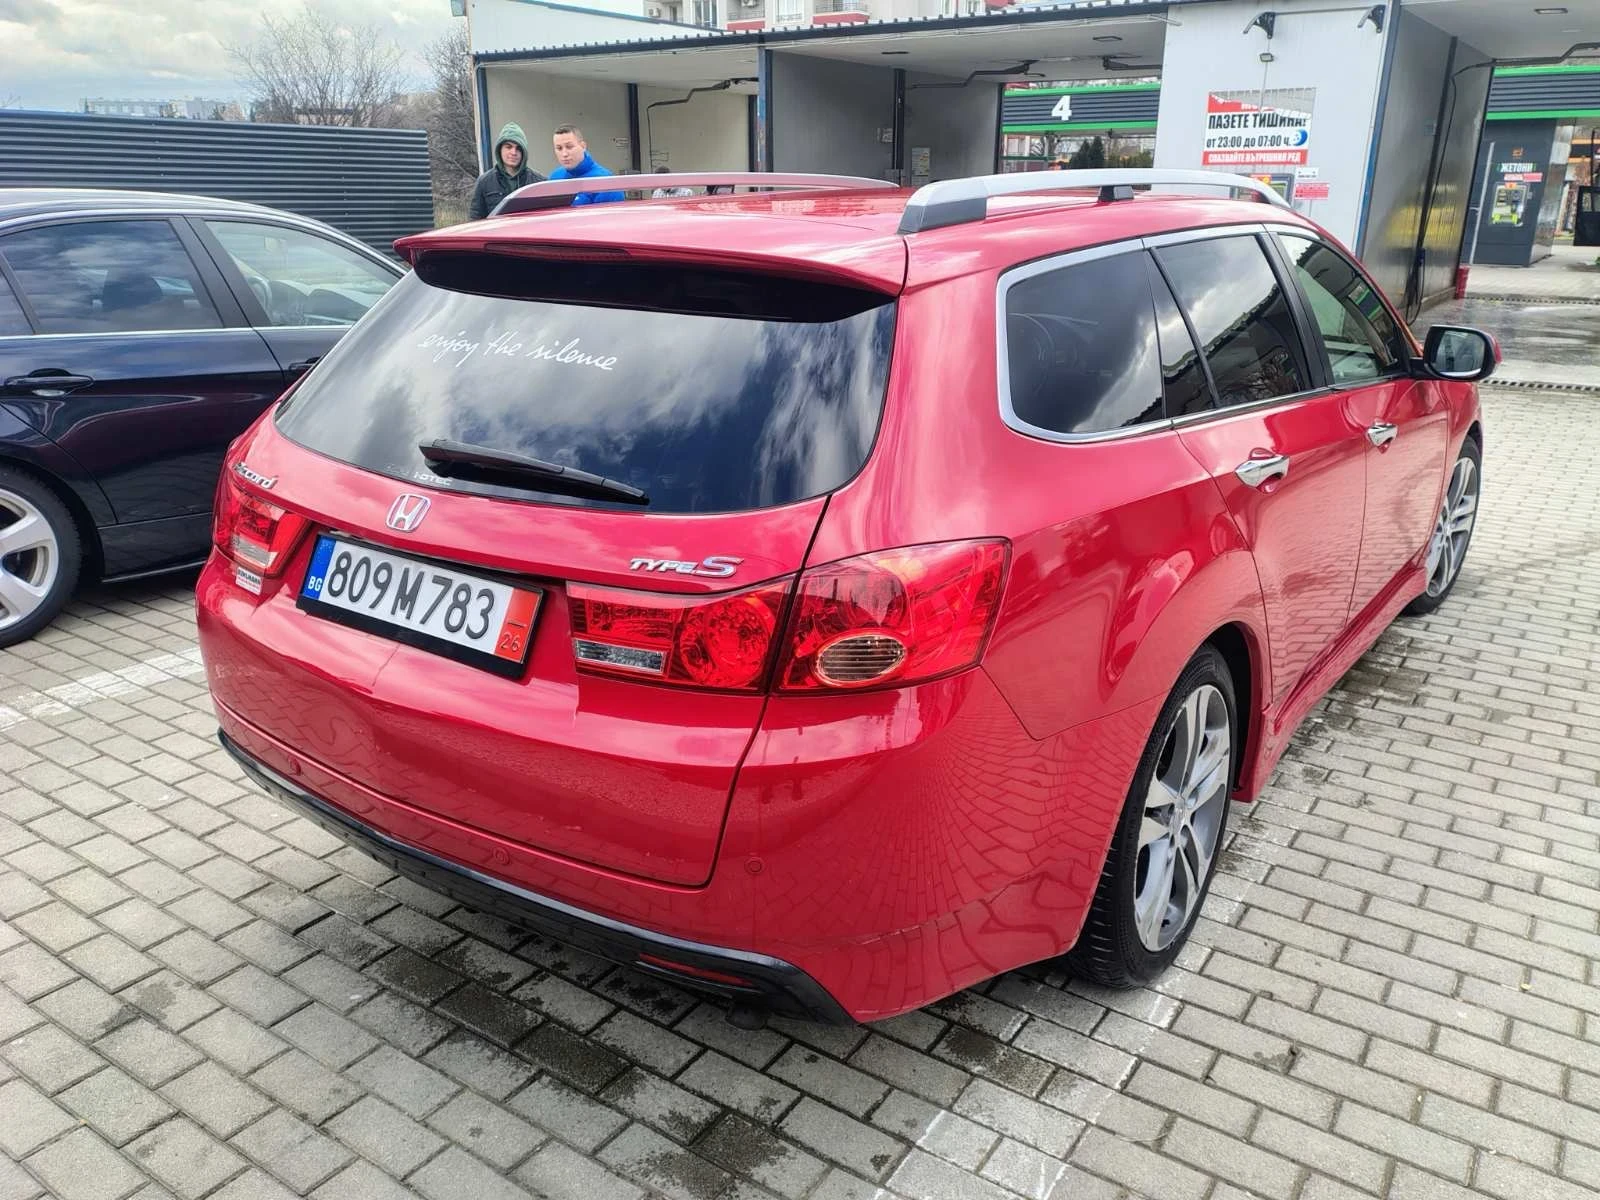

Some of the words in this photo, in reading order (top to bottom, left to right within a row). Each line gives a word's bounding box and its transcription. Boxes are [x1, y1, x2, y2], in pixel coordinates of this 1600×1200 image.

[1051, 95, 1072, 121] 4
[1208, 114, 1249, 130] ПАЗЕТЕ
[1206, 138, 1216, 148] от
[1217, 136, 1242, 148] 23:00
[1243, 138, 1255, 149] до
[1258, 135, 1282, 147] 07:00
[1500, 163, 1533, 172] ЖЕТОНИ
[417, 331, 480, 367] enjoy
[483, 331, 522, 356] the
[525, 338, 617, 370] silence
[630, 558, 698, 574] TYPE
[308, 575, 323, 591] BG
[500, 631, 521, 652] 26
